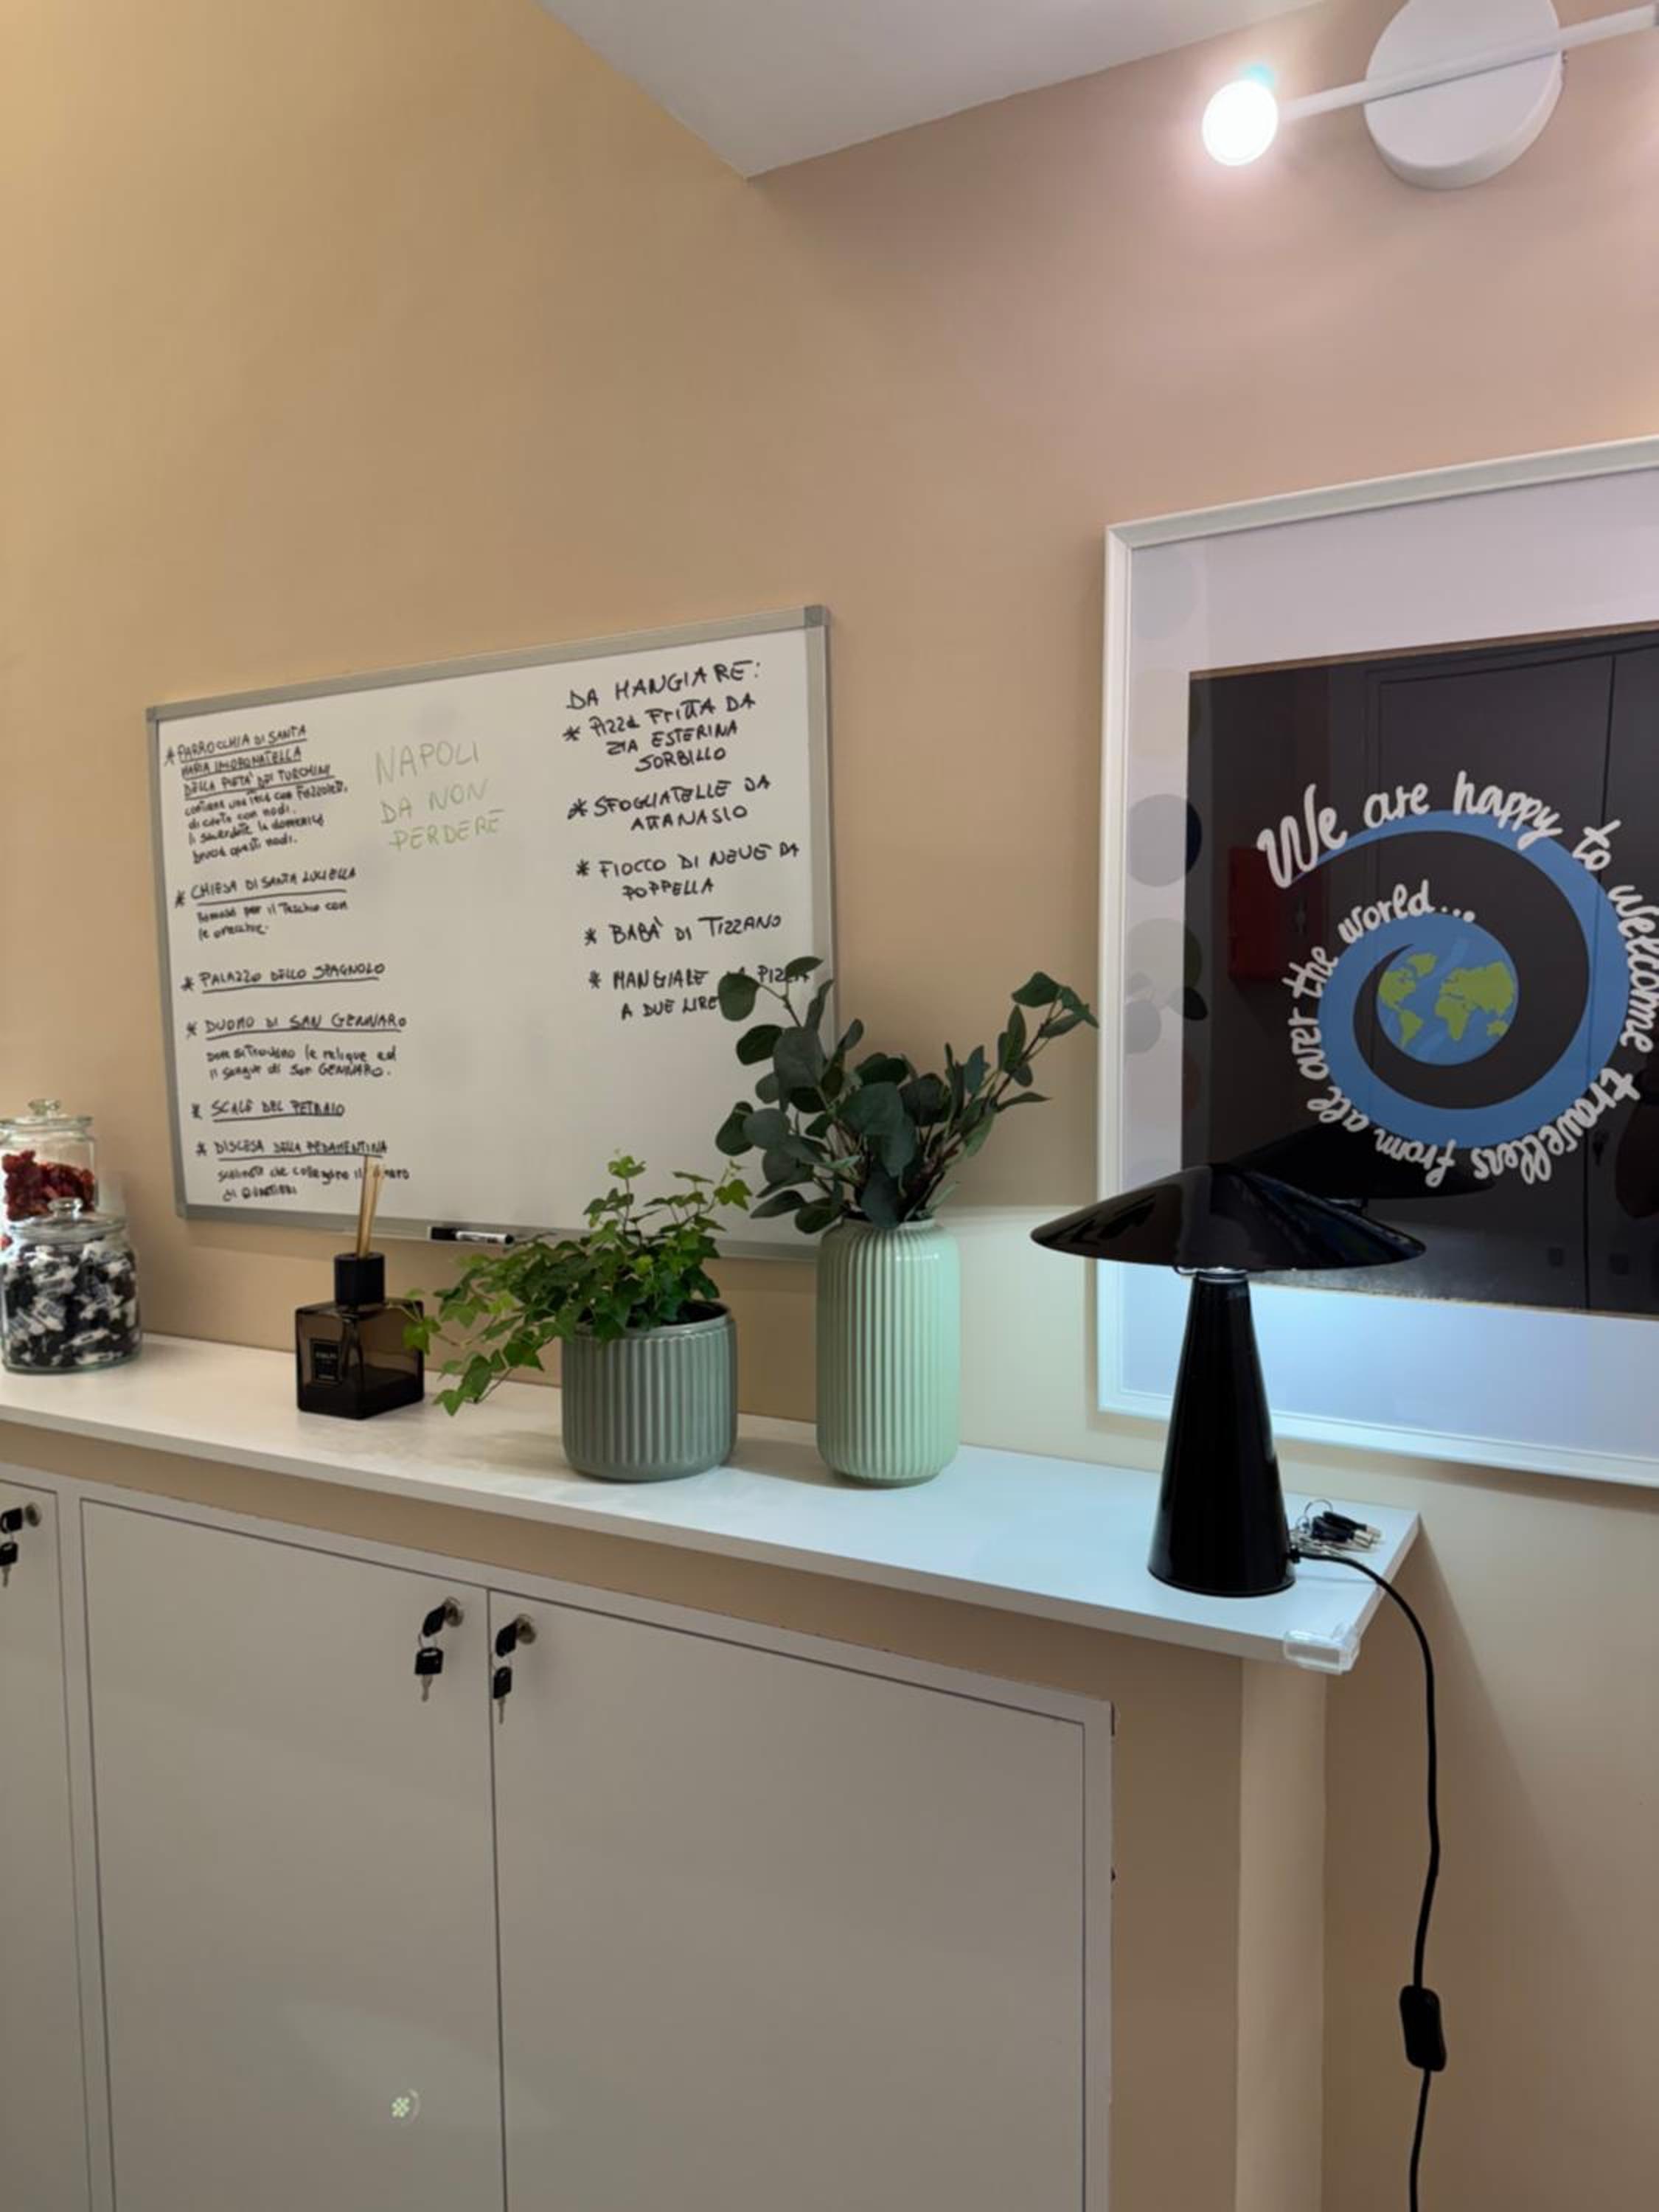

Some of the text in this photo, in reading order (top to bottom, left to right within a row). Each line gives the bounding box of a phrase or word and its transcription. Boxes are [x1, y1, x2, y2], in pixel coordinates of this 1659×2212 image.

[566, 688, 599, 709] DA
[726, 692, 755, 712] DA
[254, 734, 266, 745] DI
[268, 724, 306, 743] SANTA
[652, 720, 737, 748] ESTERINA
[375, 740, 480, 786] NAPOLI
[635, 747, 726, 772] SORBILLO
[184, 779, 216, 800] DELLA
[380, 778, 489, 824] DA NON
[594, 775, 771, 817] SFOGLIATELLE DA
[1363, 782, 1430, 828] are
[1453, 770, 1563, 850] happy
[389, 808, 505, 852] PERDERE
[1256, 783, 1348, 888] We
[599, 841, 800, 878] FIOCCO DI NEVE DA
[1572, 819, 1622, 872] to
[190, 880, 237, 900] CHIESA
[245, 877, 258, 891] DI
[261, 872, 298, 888] SANTA
[622, 877, 714, 901] POPPELLA
[675, 926, 692, 942] DI
[697, 914, 782, 937] TIZZANO
[199, 961, 386, 987] PALAZZO DELLO SPAGNOLO
[613, 969, 709, 991] MANGIARE
[1281, 946, 1339, 999] the
[1607, 885, 1659, 1054] welcome
[621, 995, 720, 1020] A DUE LIRE
[205, 1012, 408, 1033] DUOMO DI SAN GENNARO
[305, 1043, 319, 1062] le
[376, 1044, 397, 1062] ed
[1287, 1006, 1329, 1081] over
[211, 1099, 345, 1118] SCALE DEL PETRAIO
[1307, 1086, 1371, 1133] all
[1470, 1067, 1641, 1186] travellers
[214, 1141, 265, 1155] DISCESA
[1373, 1128, 1458, 1189] from
